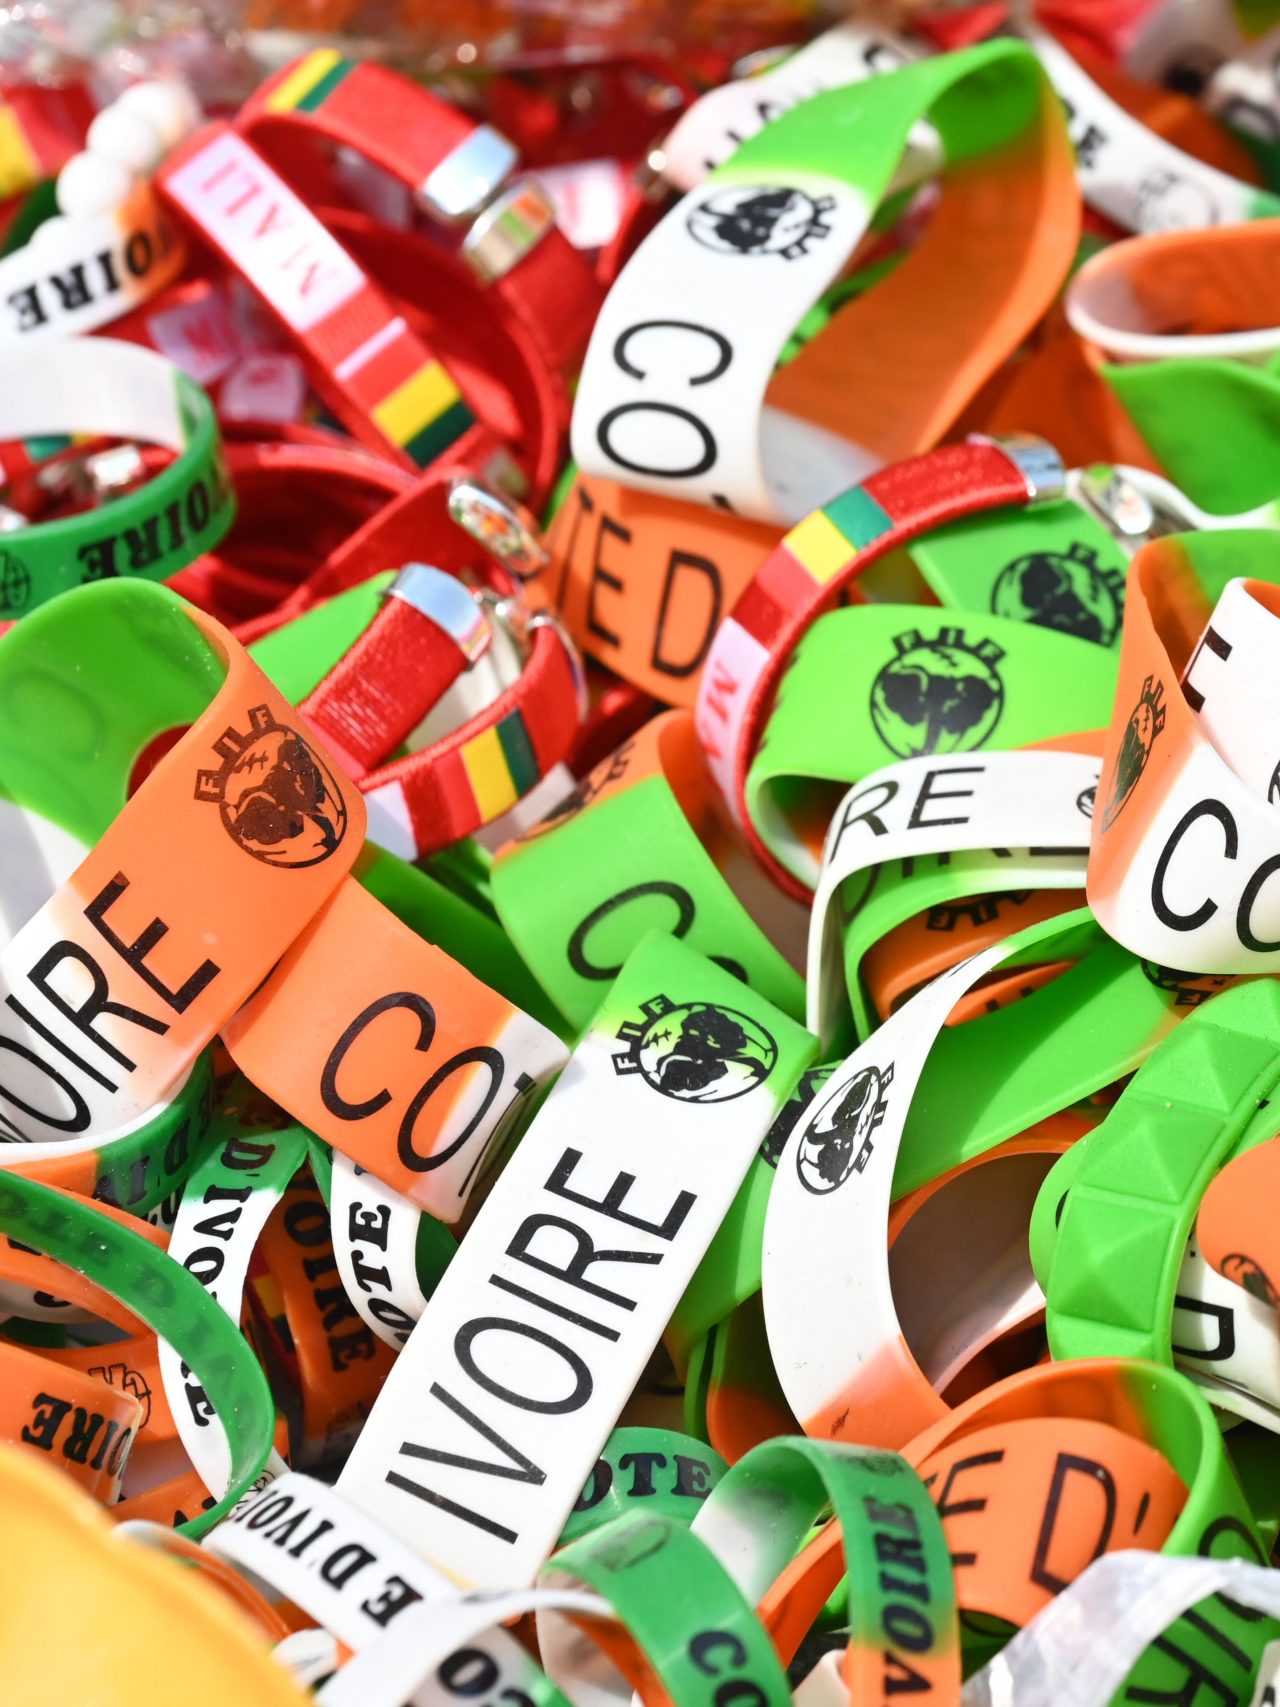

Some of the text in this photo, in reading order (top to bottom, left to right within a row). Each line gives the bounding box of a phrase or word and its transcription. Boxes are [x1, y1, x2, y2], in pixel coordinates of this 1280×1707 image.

[0, 870, 221, 1142] OIRE
[349, 1201, 418, 1349] OTE
[385, 1146, 698, 1545] IVOIRE
